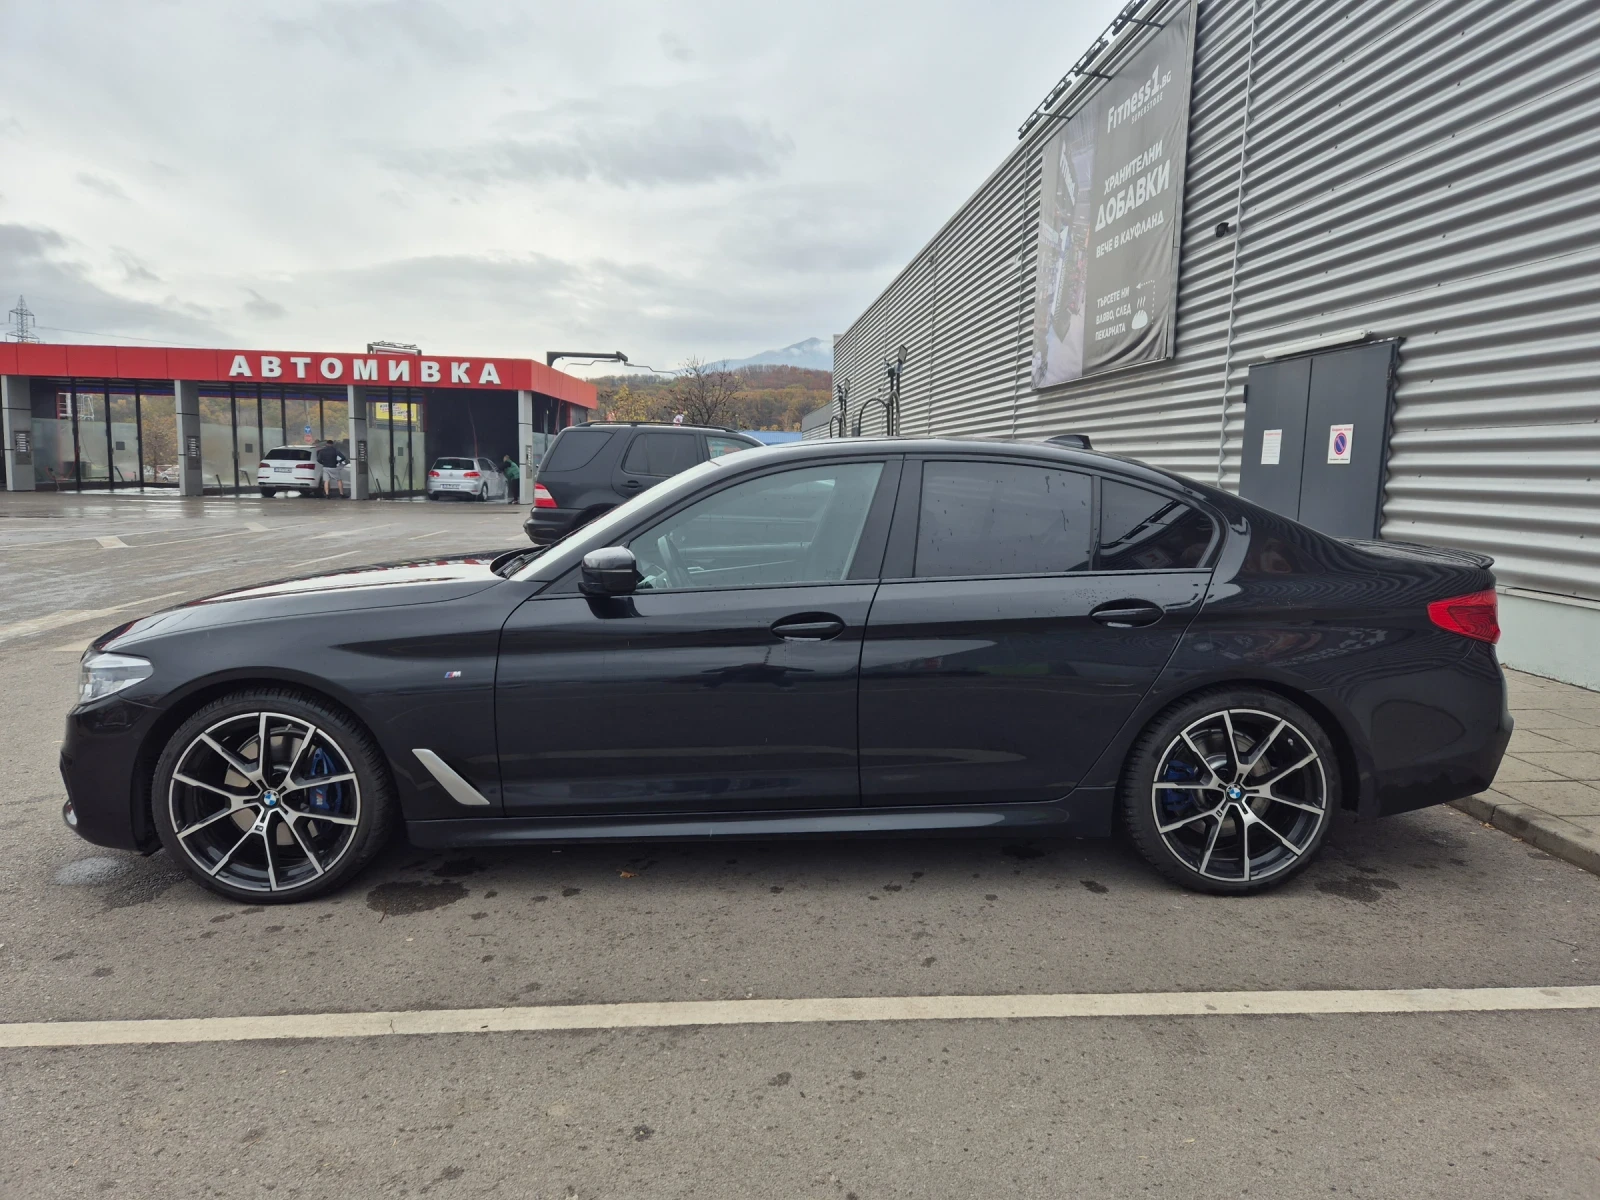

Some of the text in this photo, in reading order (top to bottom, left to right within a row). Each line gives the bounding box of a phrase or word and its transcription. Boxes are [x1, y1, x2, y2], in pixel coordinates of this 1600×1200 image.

[1131, 91, 1163, 124] SUPERSTORE
[1104, 140, 1162, 195] ХРАНИТЕЛНИ
[1095, 159, 1170, 232] ДОБАВКИ
[1096, 210, 1164, 258] ВЕЧЕ В КАУФЛАНД
[1097, 286, 1130, 308] ТЪРСЕТЕ НИ
[1096, 303, 1131, 325] ВЛЯВО, СЛЕД
[1095, 322, 1126, 340] ПЕКАРНАТА
[229, 355, 501, 385] АВТОМИВКА
